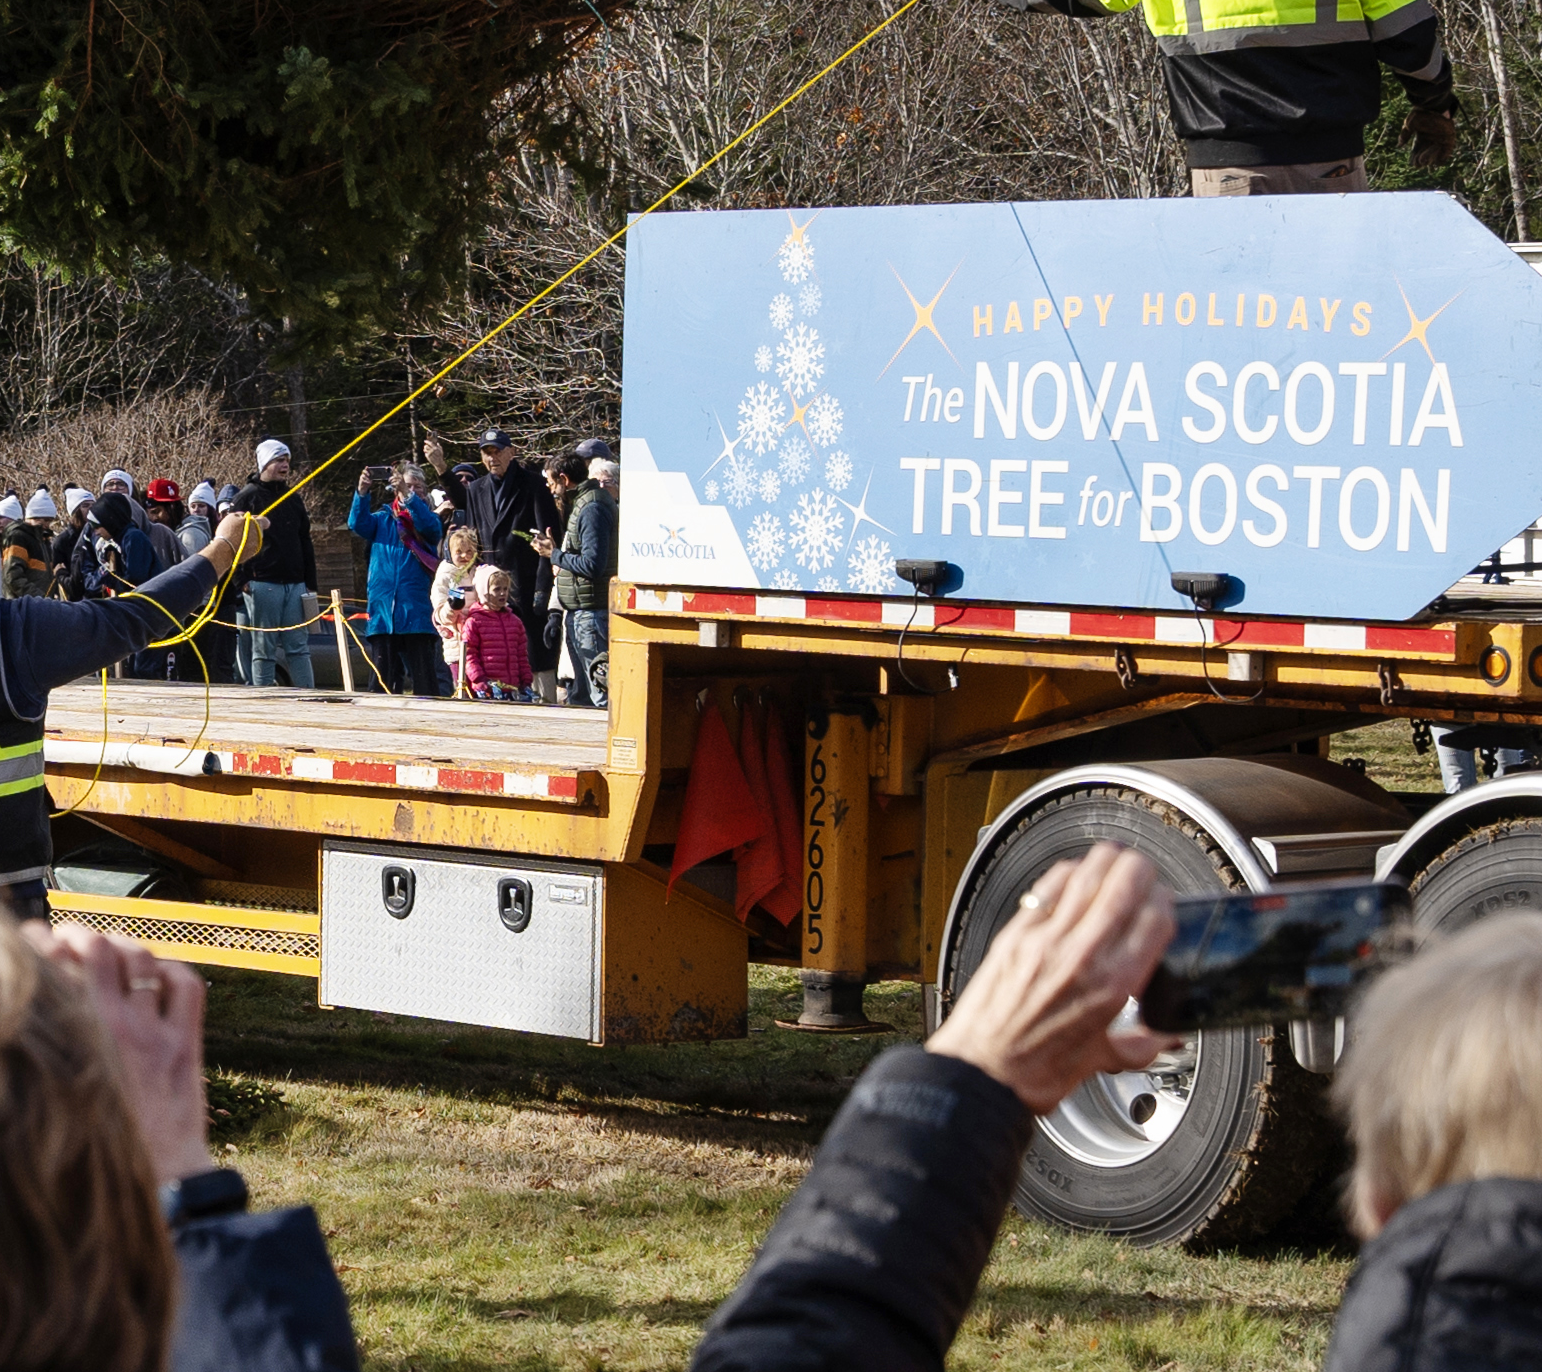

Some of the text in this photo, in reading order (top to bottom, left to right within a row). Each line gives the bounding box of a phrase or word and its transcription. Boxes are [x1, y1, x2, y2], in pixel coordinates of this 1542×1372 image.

[973, 291, 1372, 337] HAPPY HOLIDAYS
[901, 360, 1464, 447] The NOVA SCOTIA
[900, 457, 1450, 553] TREE for BOSTON
[631, 542, 716, 559] NOVA SCOTIA
[807, 743, 827, 955] 62605
